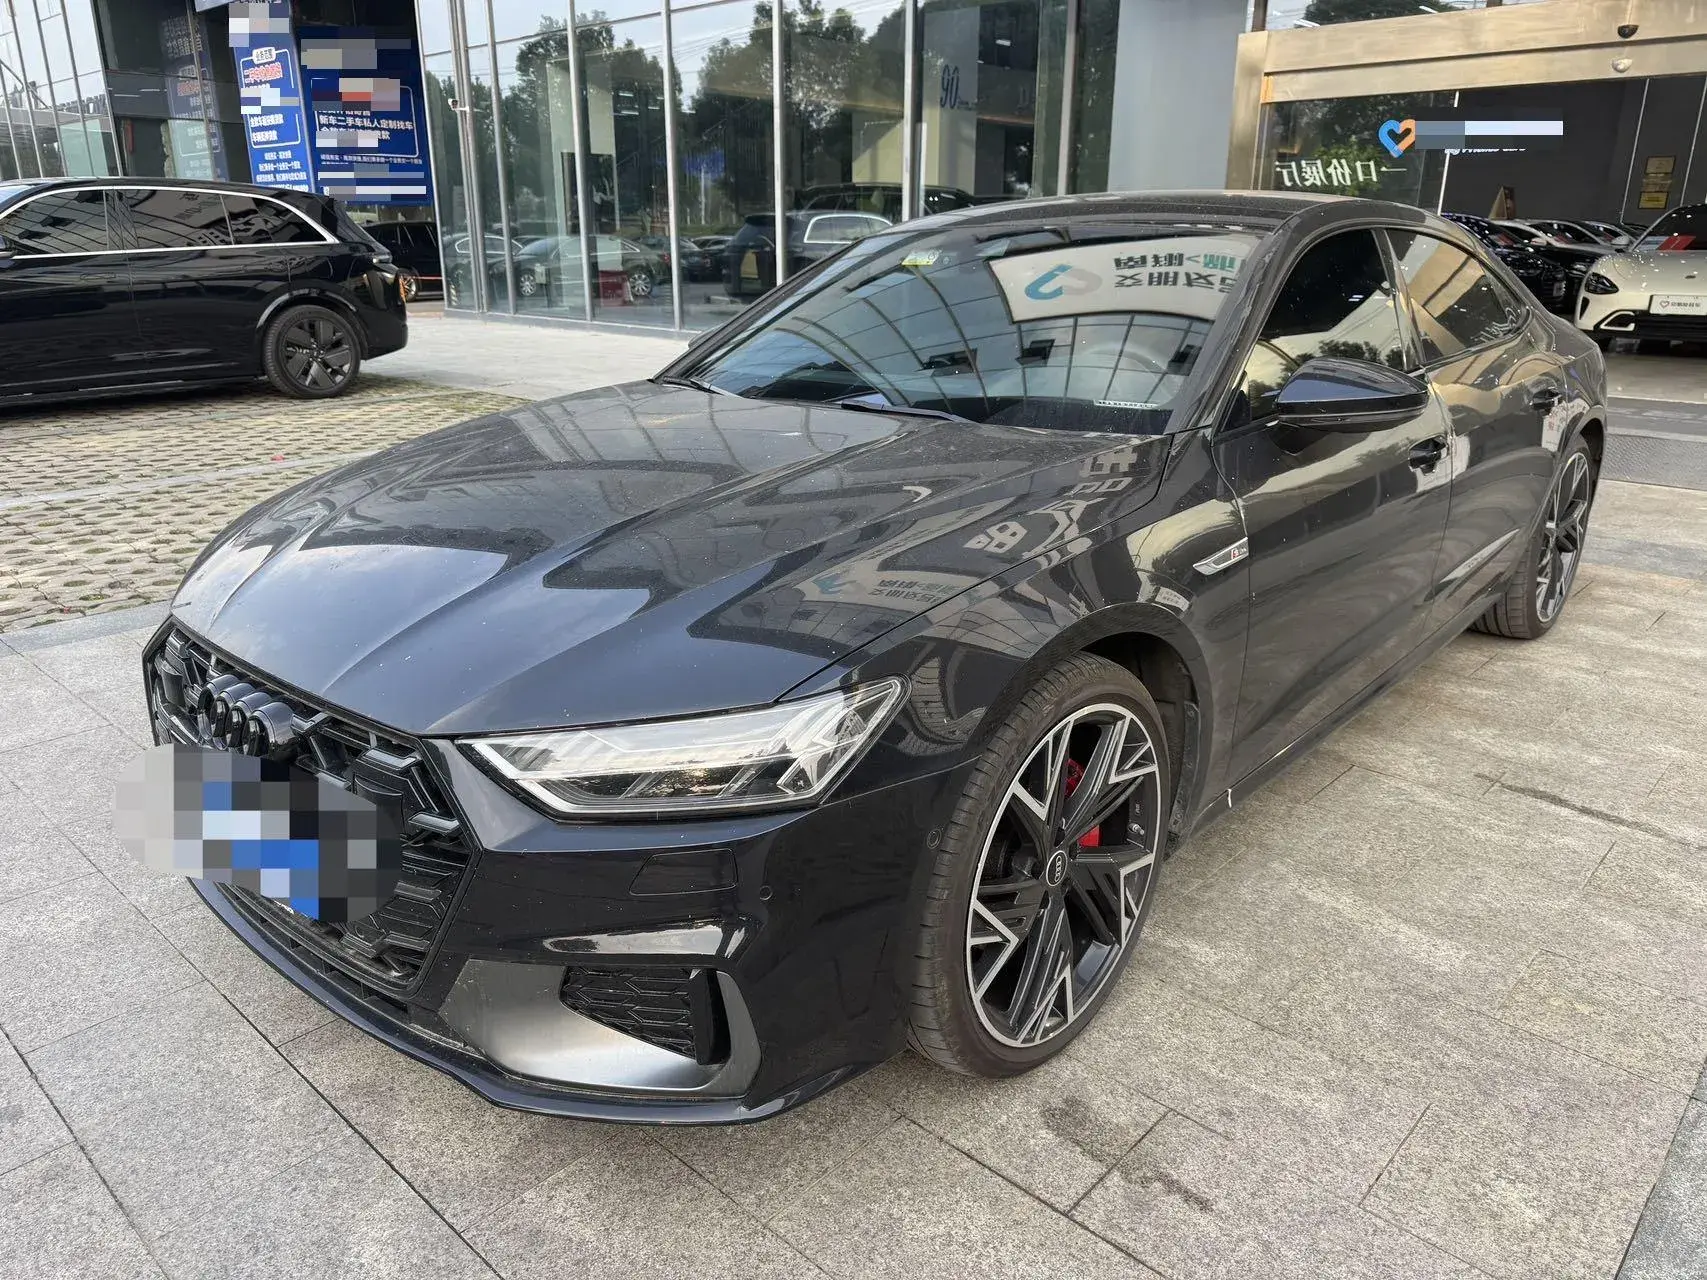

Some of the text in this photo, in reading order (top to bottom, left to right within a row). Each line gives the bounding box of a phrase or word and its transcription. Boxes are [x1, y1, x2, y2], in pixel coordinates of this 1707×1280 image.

[319, 115, 414, 130] 新车二手车私人定制找车
